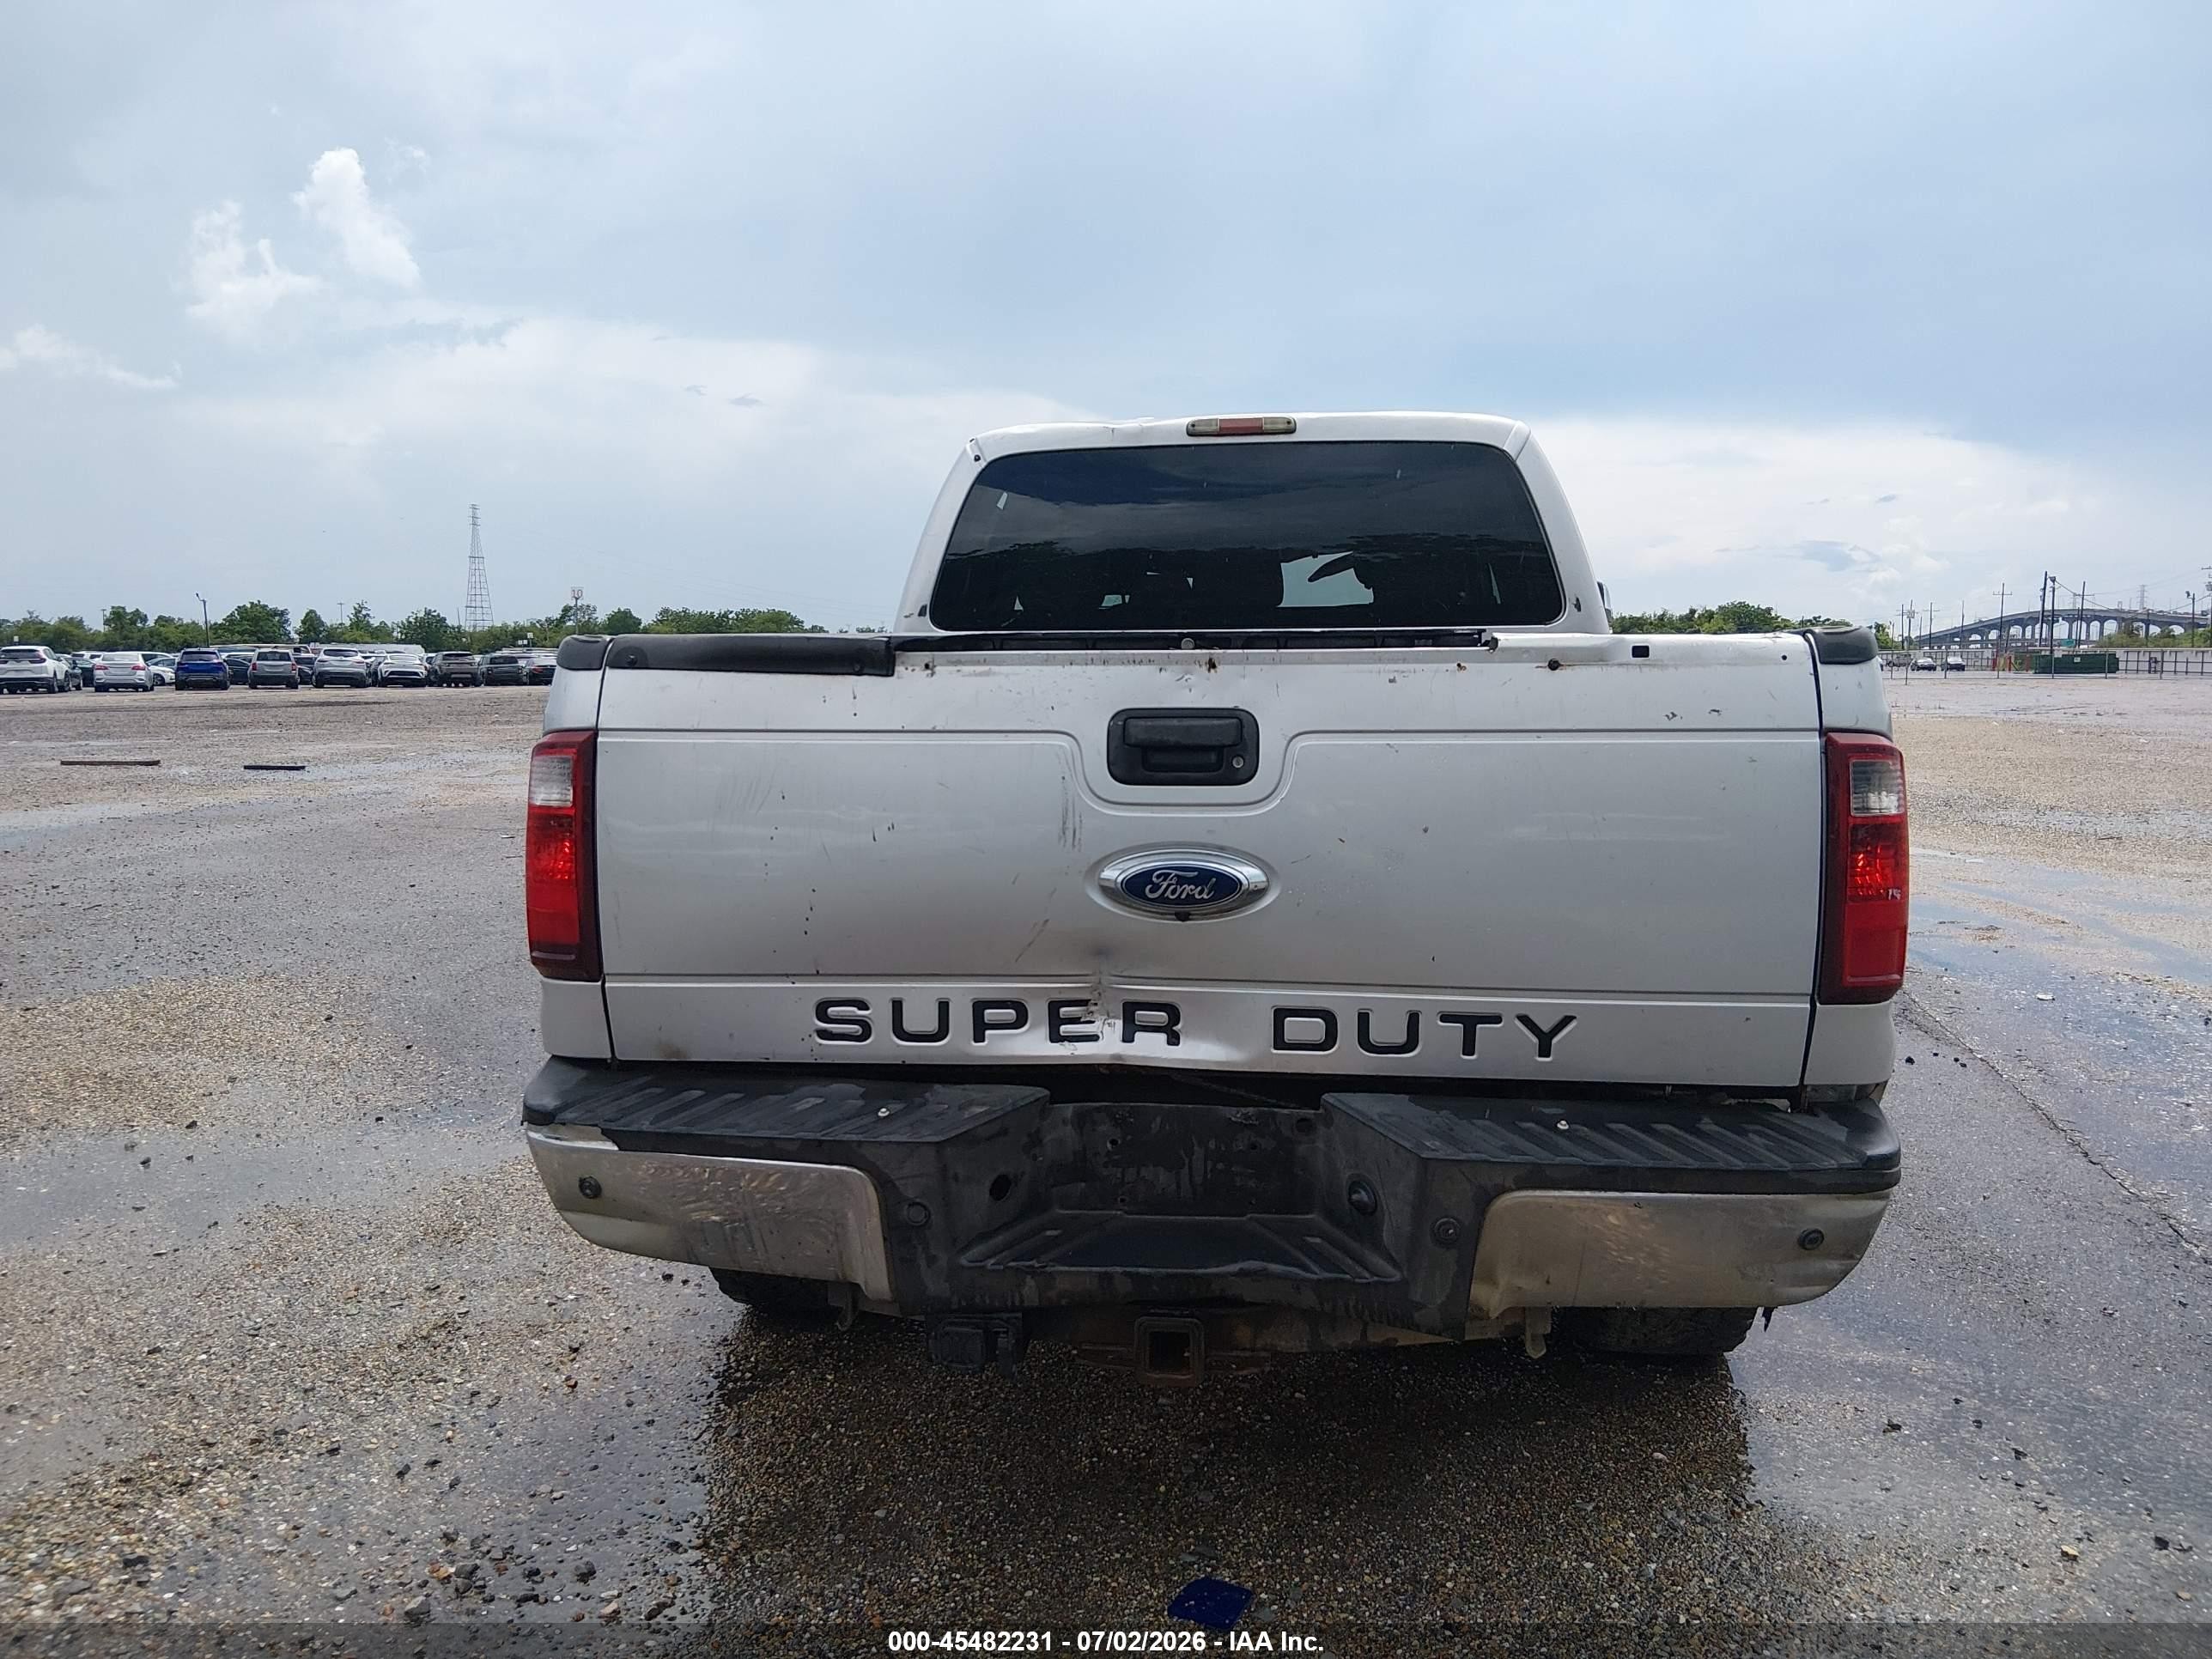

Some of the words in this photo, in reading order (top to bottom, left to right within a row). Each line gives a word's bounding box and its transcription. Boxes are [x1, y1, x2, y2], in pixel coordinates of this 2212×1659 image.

[1145, 869, 1217, 900] Ford
[815, 998, 1182, 1047] SUPER
[1272, 1006, 1578, 1060] DUTY
